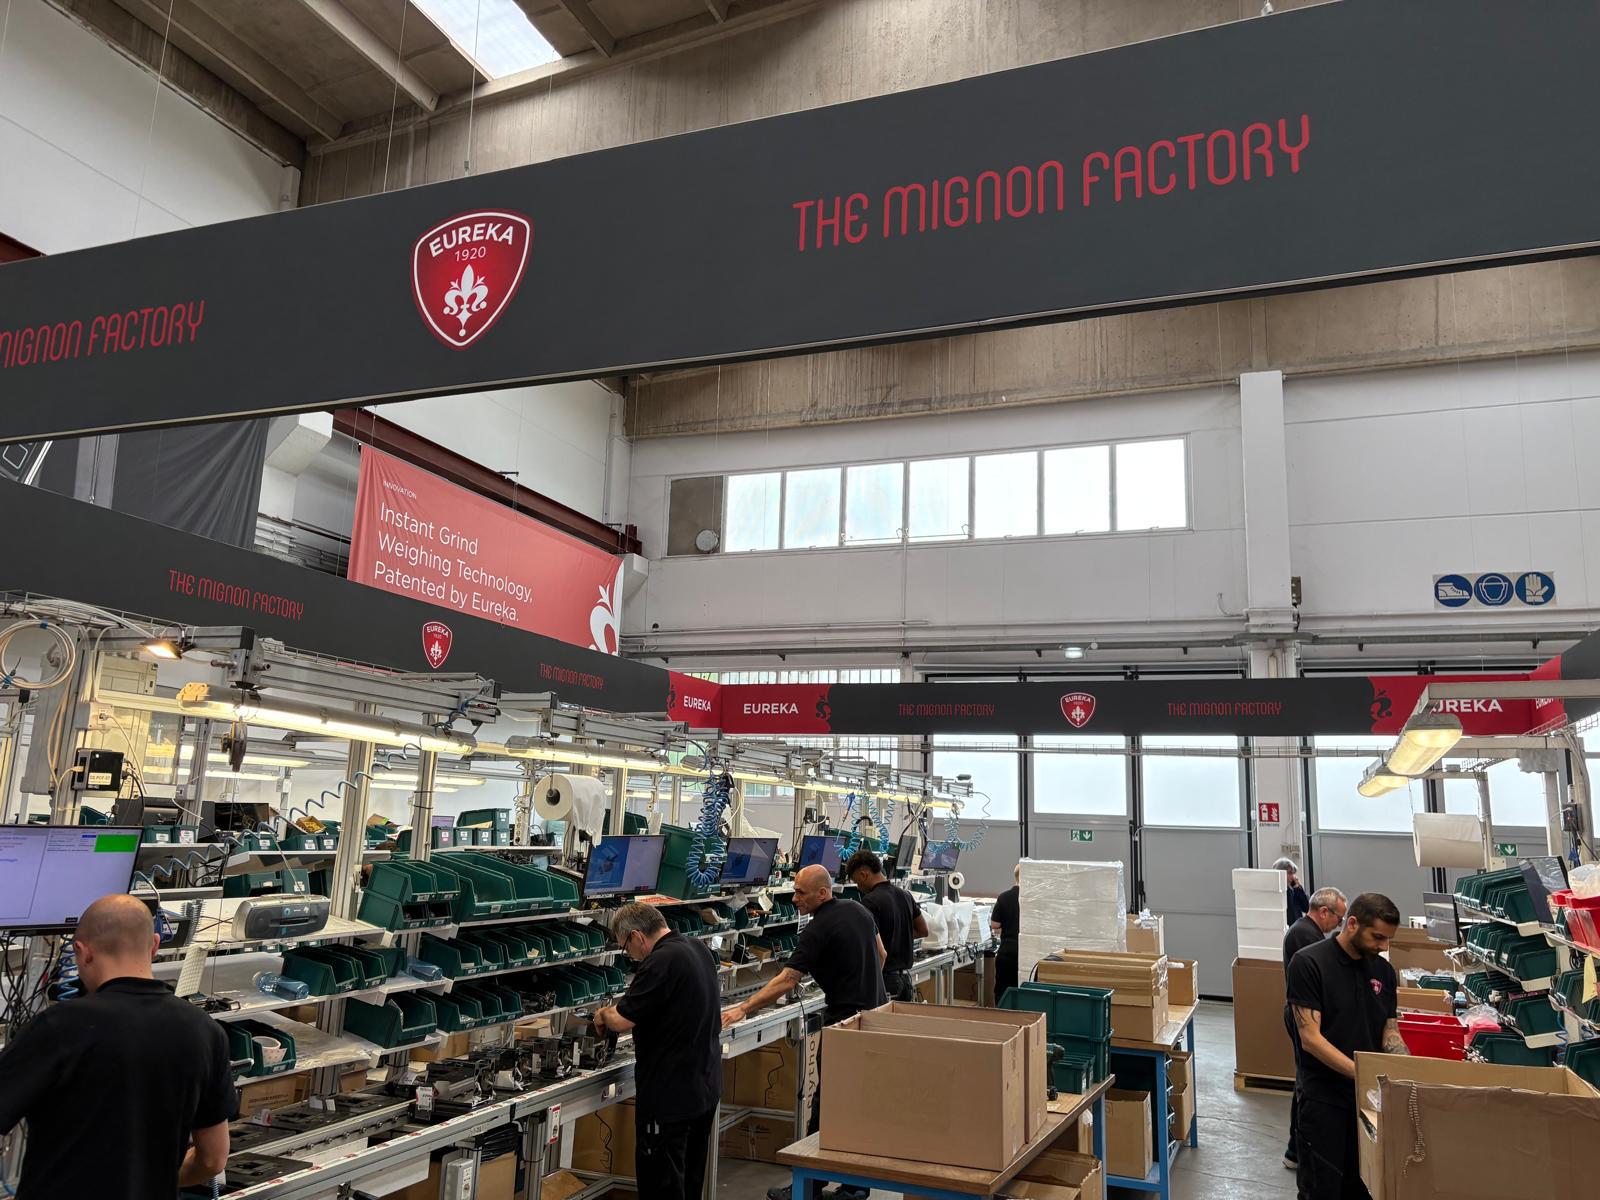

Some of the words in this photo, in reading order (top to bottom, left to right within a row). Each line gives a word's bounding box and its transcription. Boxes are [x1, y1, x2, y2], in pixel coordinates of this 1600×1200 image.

[793, 193, 868, 251] THE
[883, 160, 1064, 238] MIGNON
[1082, 114, 1310, 207] FACTORY
[429, 222, 514, 257] EUREKA
[455, 246, 487, 262] 1920
[88, 300, 205, 356] FACTORY
[383, 480, 417, 499] INNOVATION
[380, 502, 434, 540] Instant
[439, 526, 478, 555] Grind
[378, 530, 451, 576] Weighing
[457, 559, 533, 603] Technology,
[169, 570, 195, 595] THE
[198, 577, 250, 608] MIGNON
[253, 592, 304, 620] FACTORY
[374, 561, 446, 600] Patented
[450, 584, 468, 609] by
[472, 592, 519, 621] Eureka.
[426, 625, 449, 638] EUREKA
[683, 695, 712, 712] EUREKA
[1064, 695, 1091, 703] EUREKA
[1436, 699, 1504, 713] REKA
[743, 703, 799, 714] EUREKA
[898, 703, 914, 716] THE
[1168, 702, 1187, 716] THE
